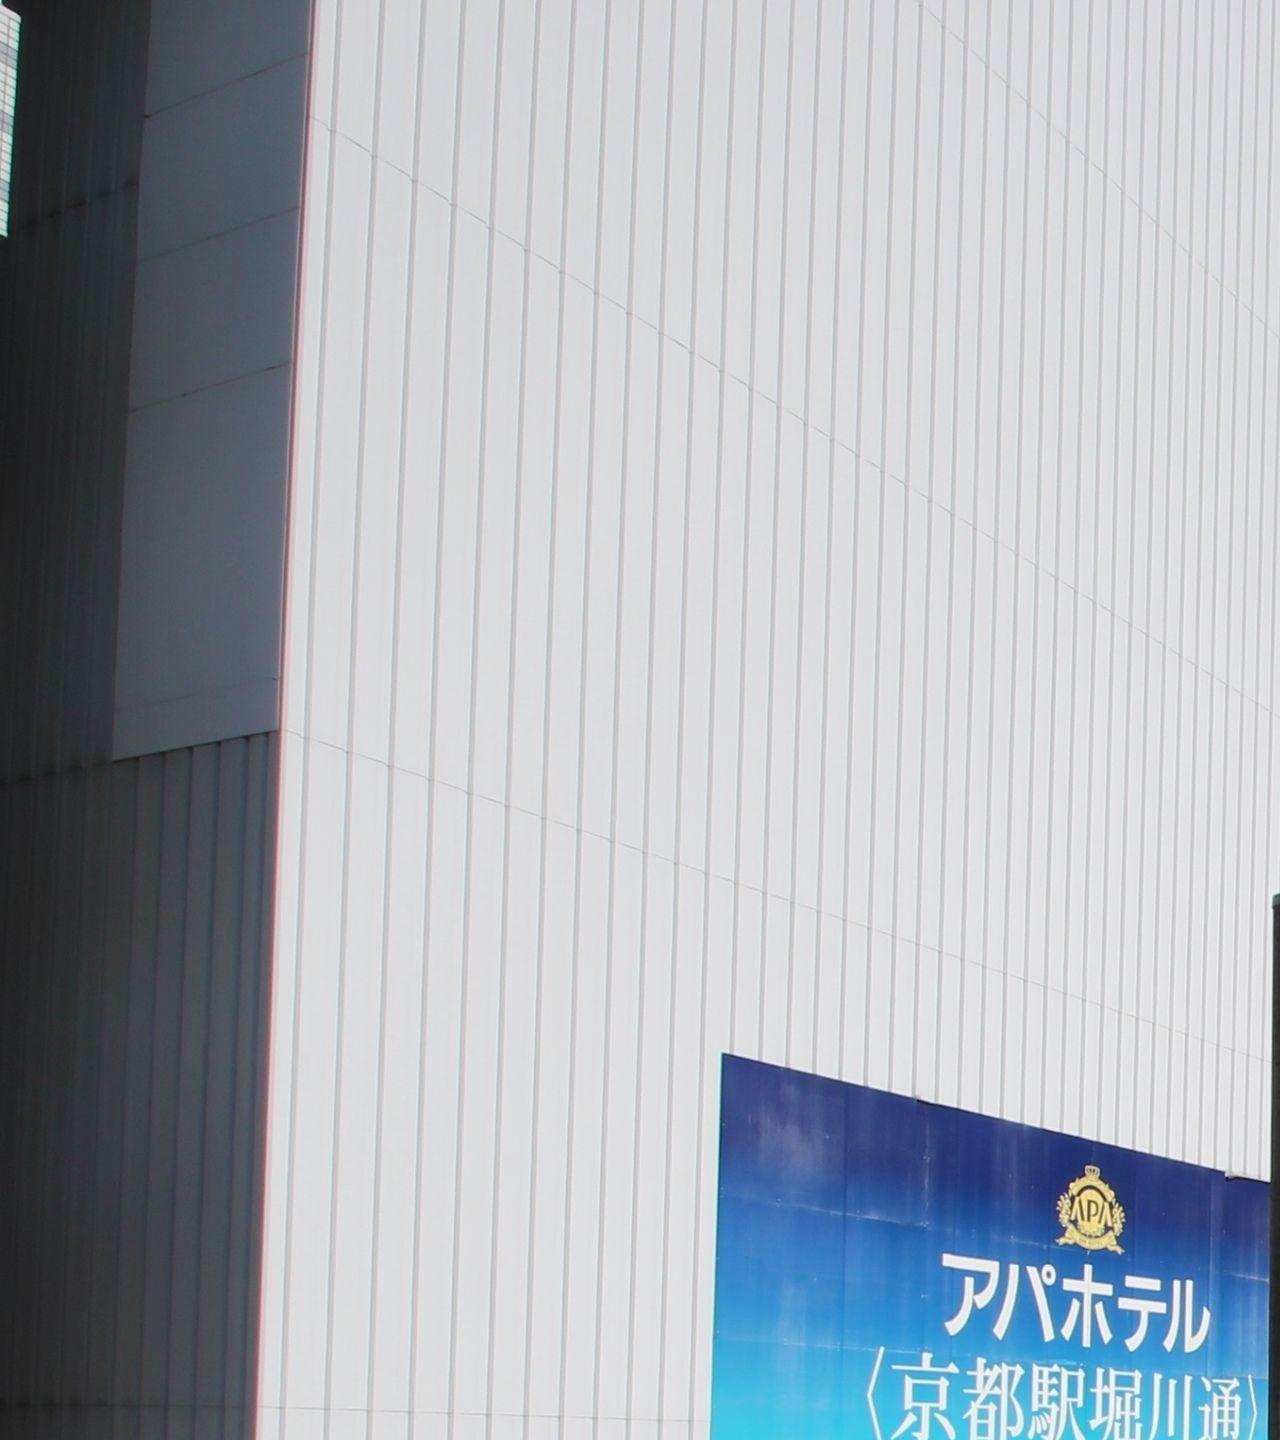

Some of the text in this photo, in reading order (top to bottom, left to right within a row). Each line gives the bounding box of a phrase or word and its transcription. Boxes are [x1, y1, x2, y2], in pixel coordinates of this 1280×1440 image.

[941, 1253, 1211, 1354] アパホテル
